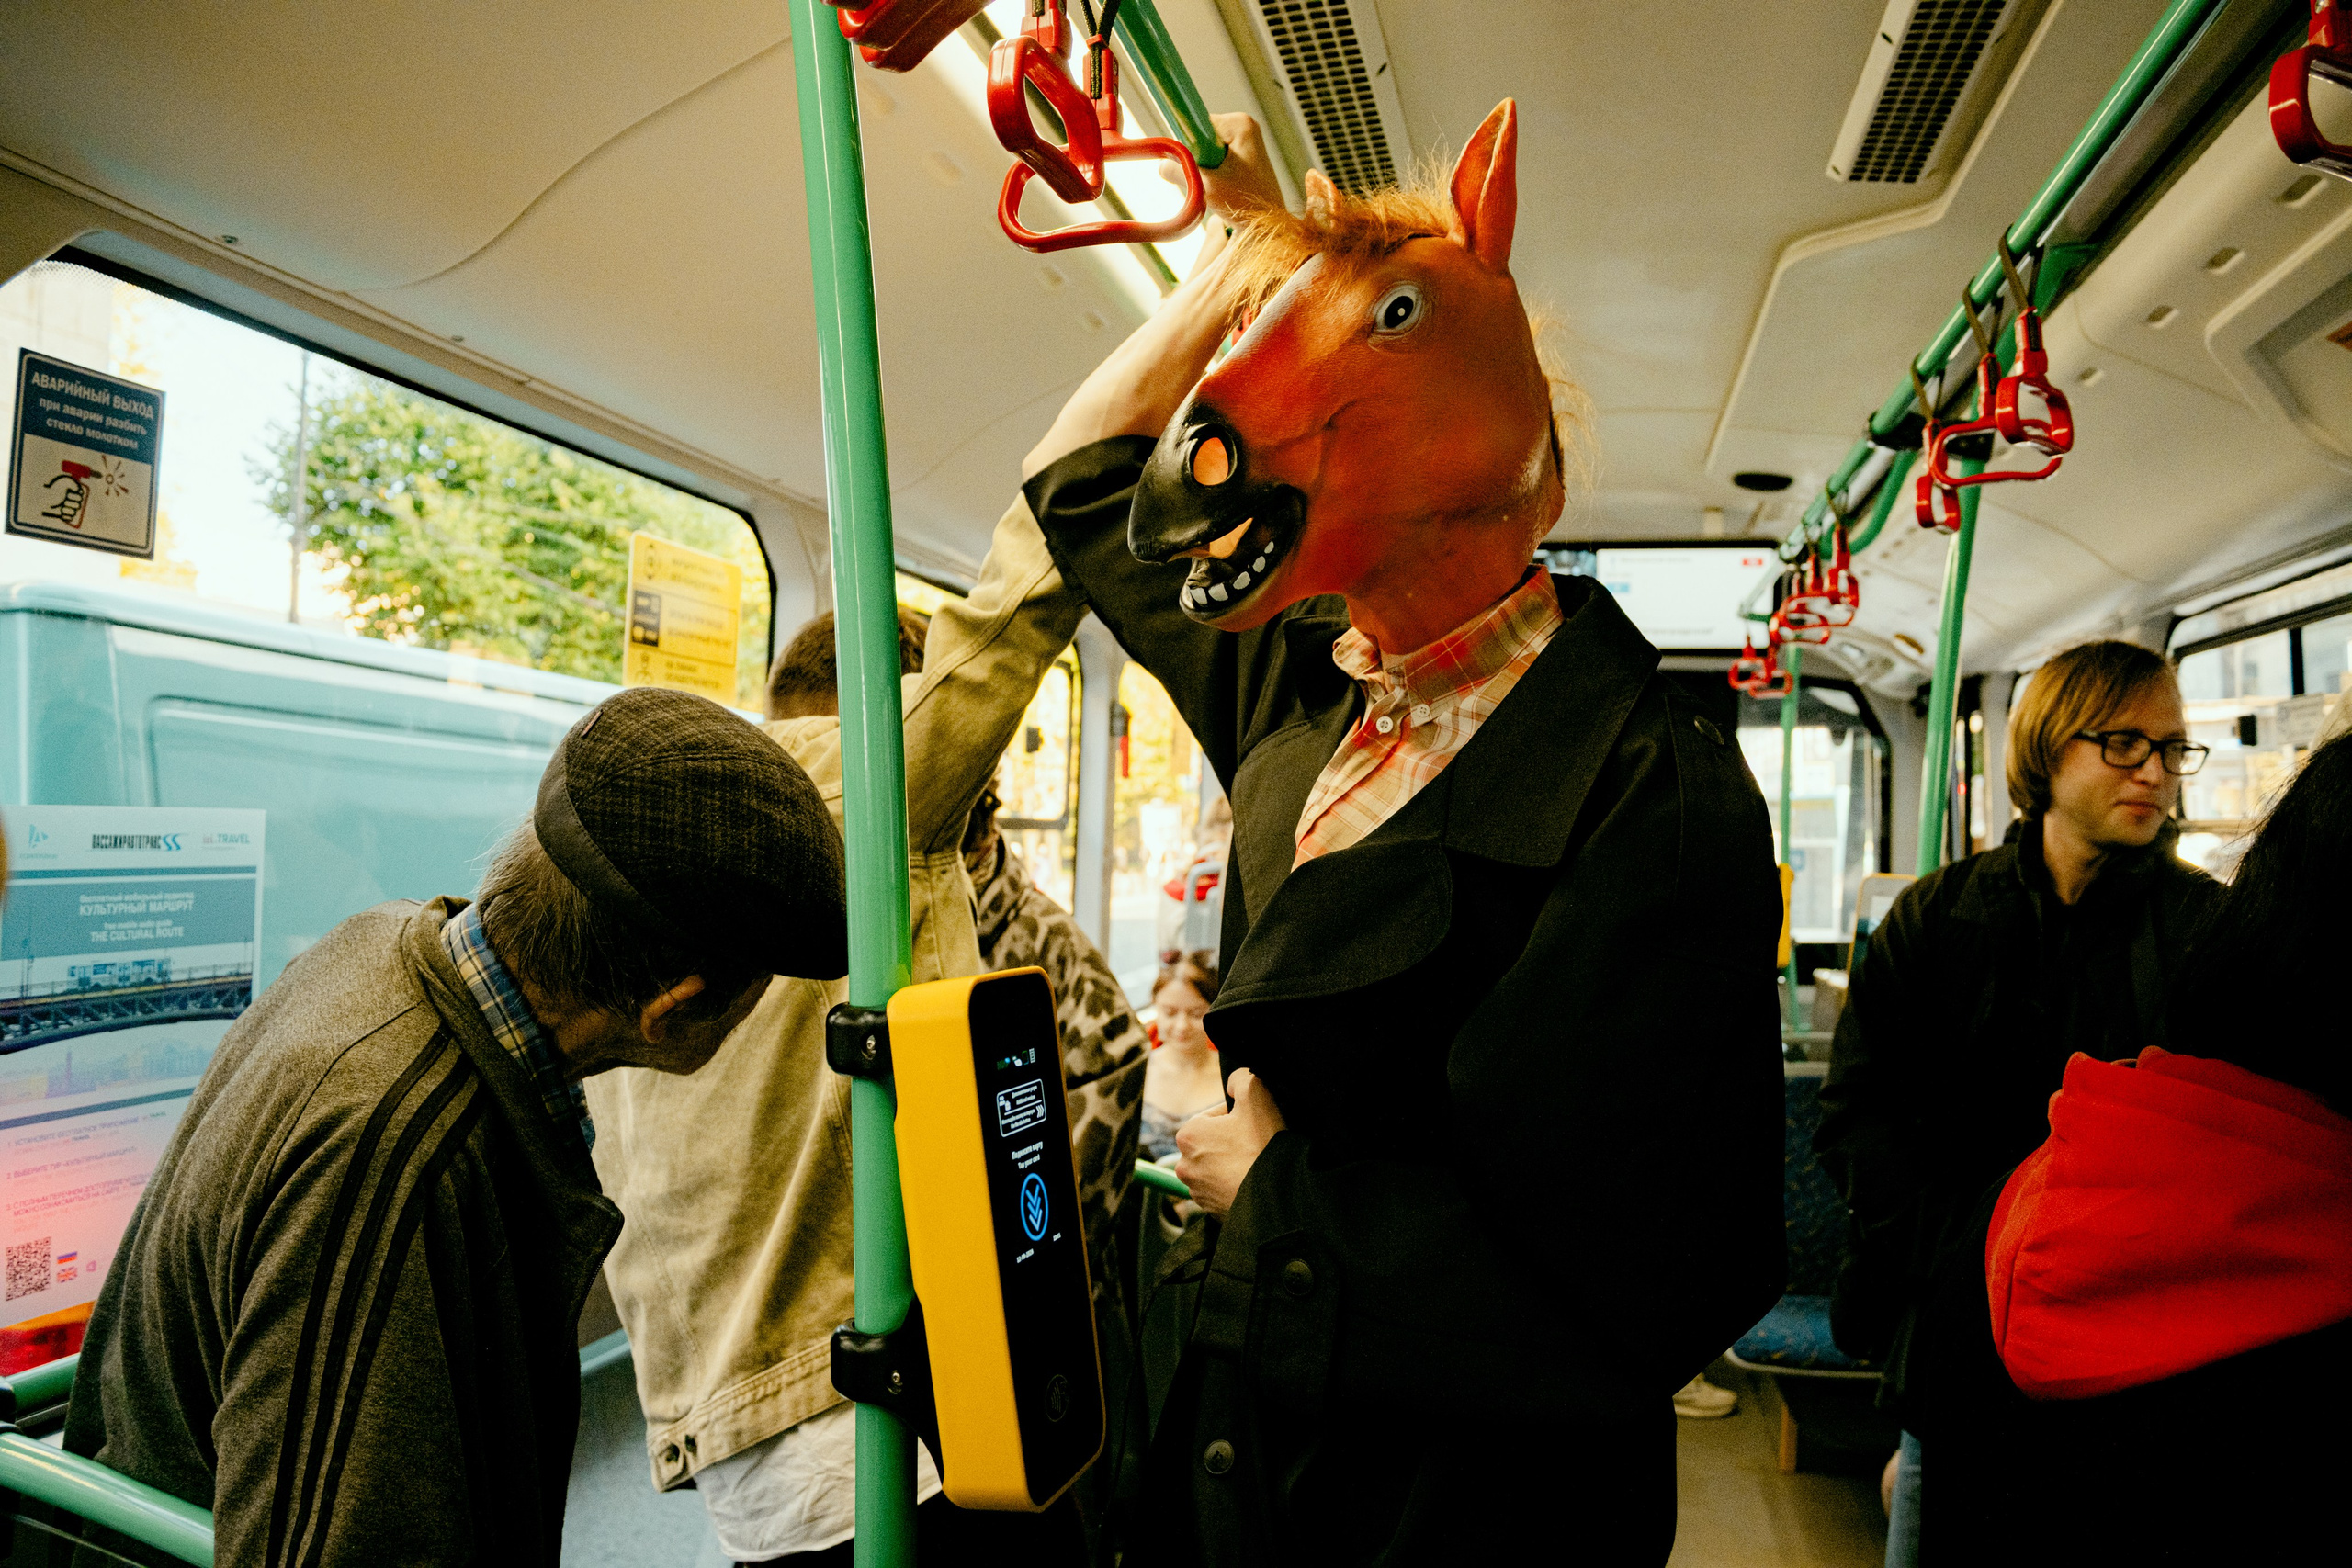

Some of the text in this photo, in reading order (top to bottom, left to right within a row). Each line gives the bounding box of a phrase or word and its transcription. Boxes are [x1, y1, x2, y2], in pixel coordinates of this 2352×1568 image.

[31, 371, 154, 421] АВАРИЙНЫЙ ВЫХОД
[40, 398, 147, 435] при аварии разбить
[46, 417, 139, 449] стекло молотком
[79, 899, 194, 916] КУЛЬТУРНЫЙ МАРШРУТ
[90, 926, 185, 942] THE CULTURAL ROUTE
